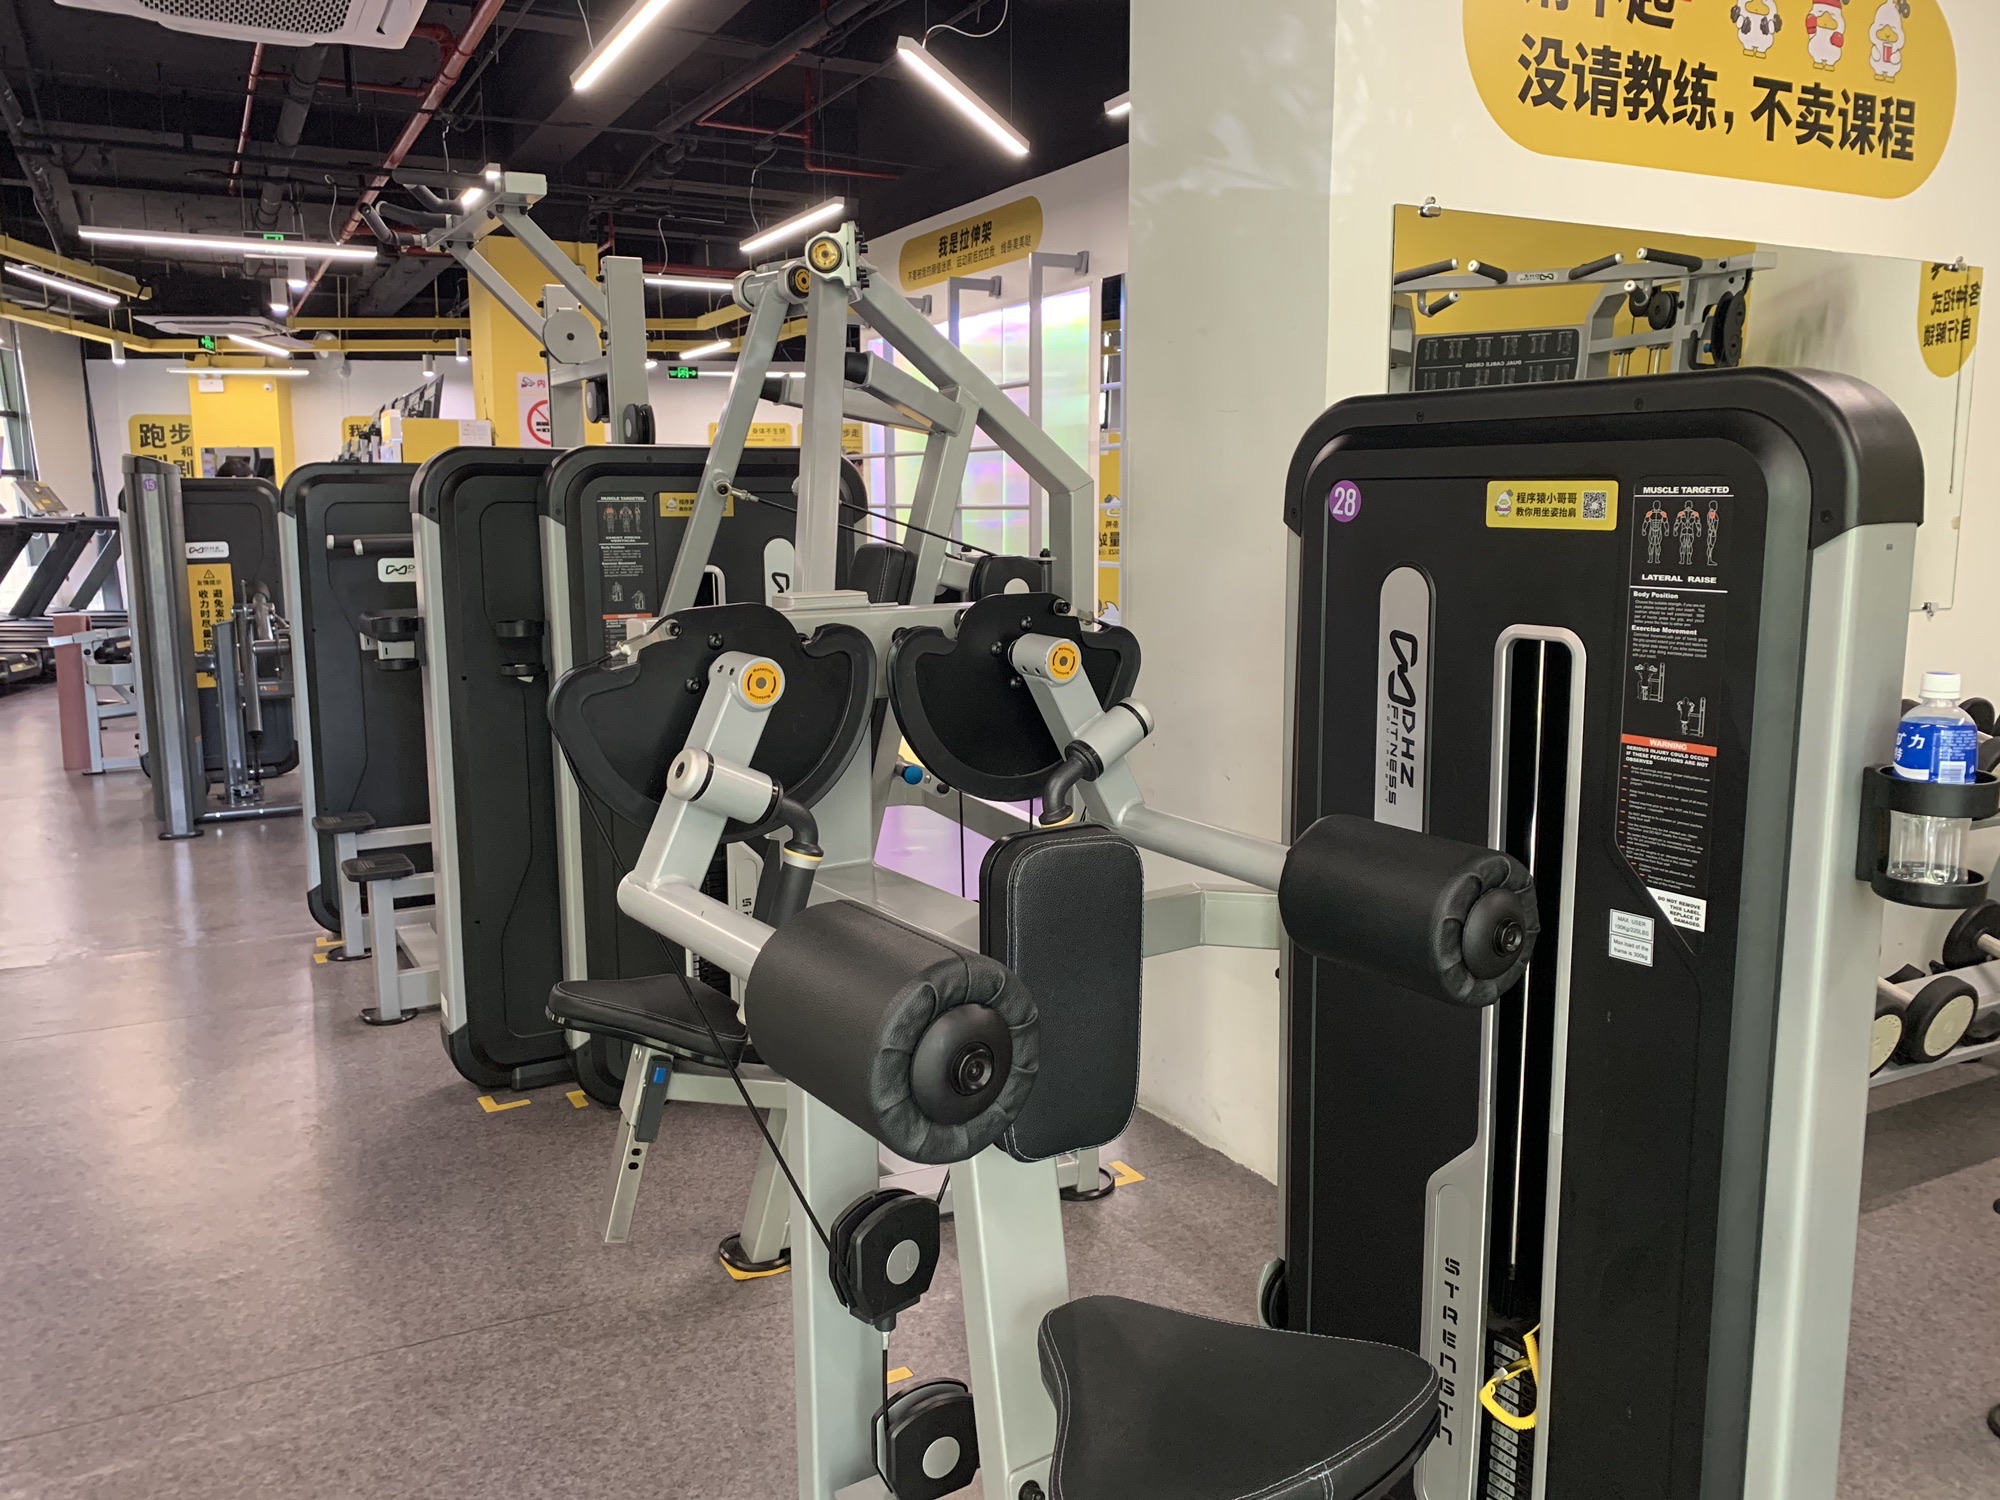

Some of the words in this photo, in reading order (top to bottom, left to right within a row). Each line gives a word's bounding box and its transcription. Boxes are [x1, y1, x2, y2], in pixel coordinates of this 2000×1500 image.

[1518, 33, 1916, 161] 没请教练，不卖课程
[938, 220, 993, 258] 我是拉伸架
[139, 423, 191, 448] 跑步
[181, 446, 193, 457] 和
[145, 481, 155, 489] 15
[1643, 486, 1679, 494] MUSCLE
[1681, 486, 1730, 494] TARGETED
[1333, 486, 1357, 516] 28
[1516, 492, 1578, 505] 程序猿小哥哥
[1641, 573, 1683, 582] LATERAL
[1688, 575, 1717, 584] RAISE
[1633, 590, 1649, 599] Body
[1651, 591, 1679, 599] Position
[1631, 625, 1660, 633] Exercise
[1662, 627, 1697, 636] Movement
[1400, 709, 1416, 788] DHZ
[1650, 739, 1688, 751] WARNING
[1388, 704, 1399, 806] FITNESS
[1626, 745, 1649, 753] SERIOUS
[1650, 747, 1670, 756] INJURY
[1671, 751, 1689, 759] COULD
[1690, 754, 1709, 762] OCCUR
[1626, 757, 1654, 765] OBSERVED
[1678, 901, 1701, 910] REMOVE
[1669, 910, 1694, 920] REPLACE
[1631, 919, 1646, 927] USER
[1436, 1257, 1460, 1446] STRENGTH
